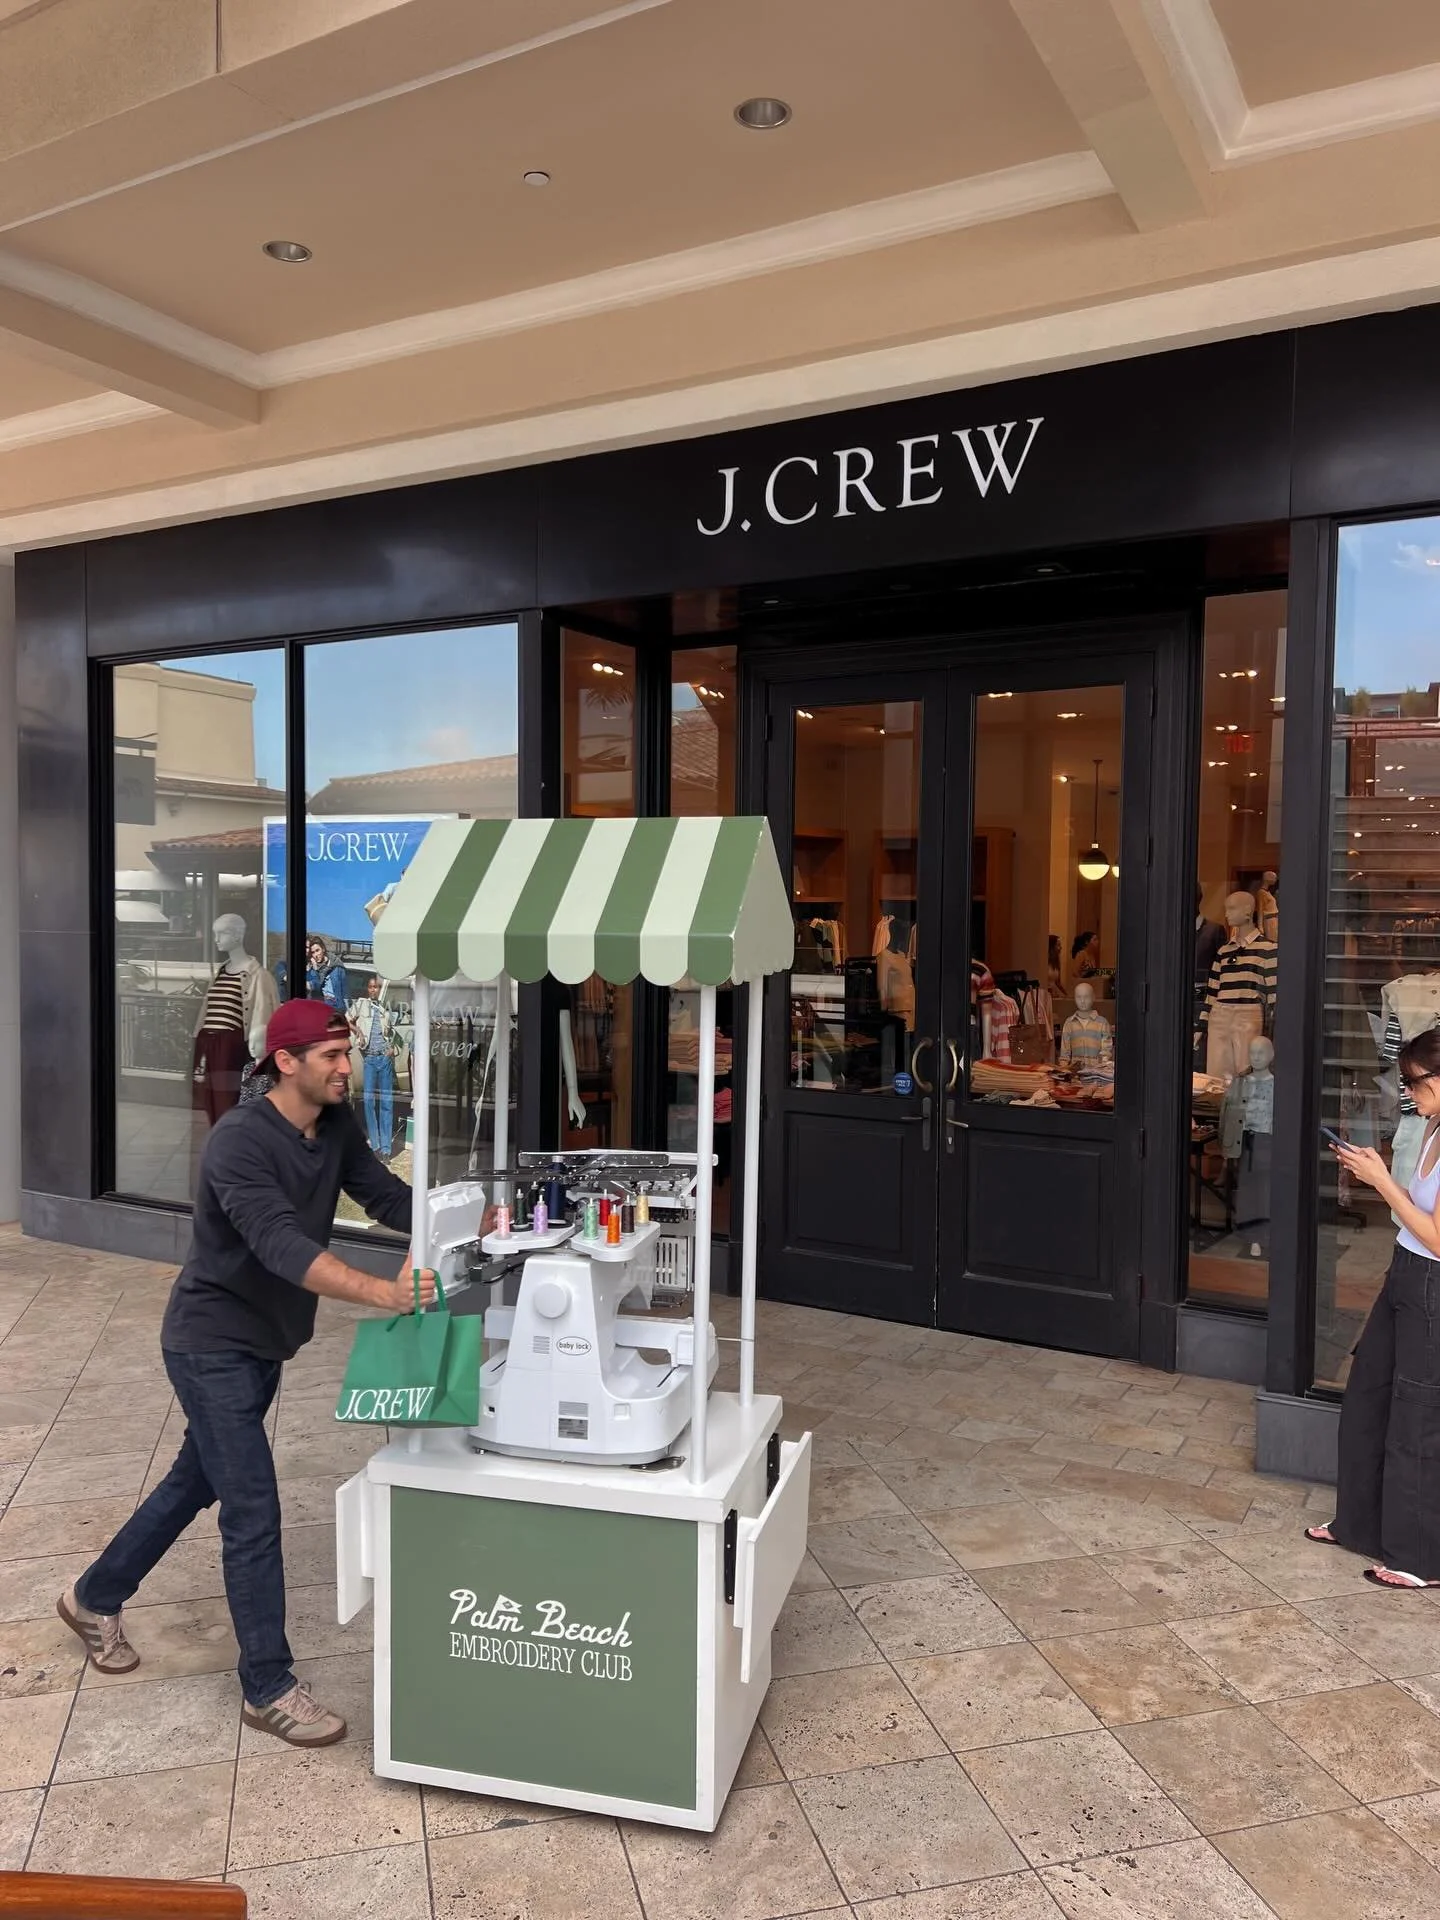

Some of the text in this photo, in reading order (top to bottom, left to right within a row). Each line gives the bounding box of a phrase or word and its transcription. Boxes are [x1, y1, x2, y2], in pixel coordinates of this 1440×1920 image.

[697, 416, 1045, 536] J.CREW
[308, 832, 409, 862] J.CREW
[558, 1341, 589, 1350] baby lock
[335, 1386, 436, 1420] J.CREW
[449, 1588, 633, 1648] Palm Beach
[449, 1631, 633, 1682] EMBROIDERY CLUB
